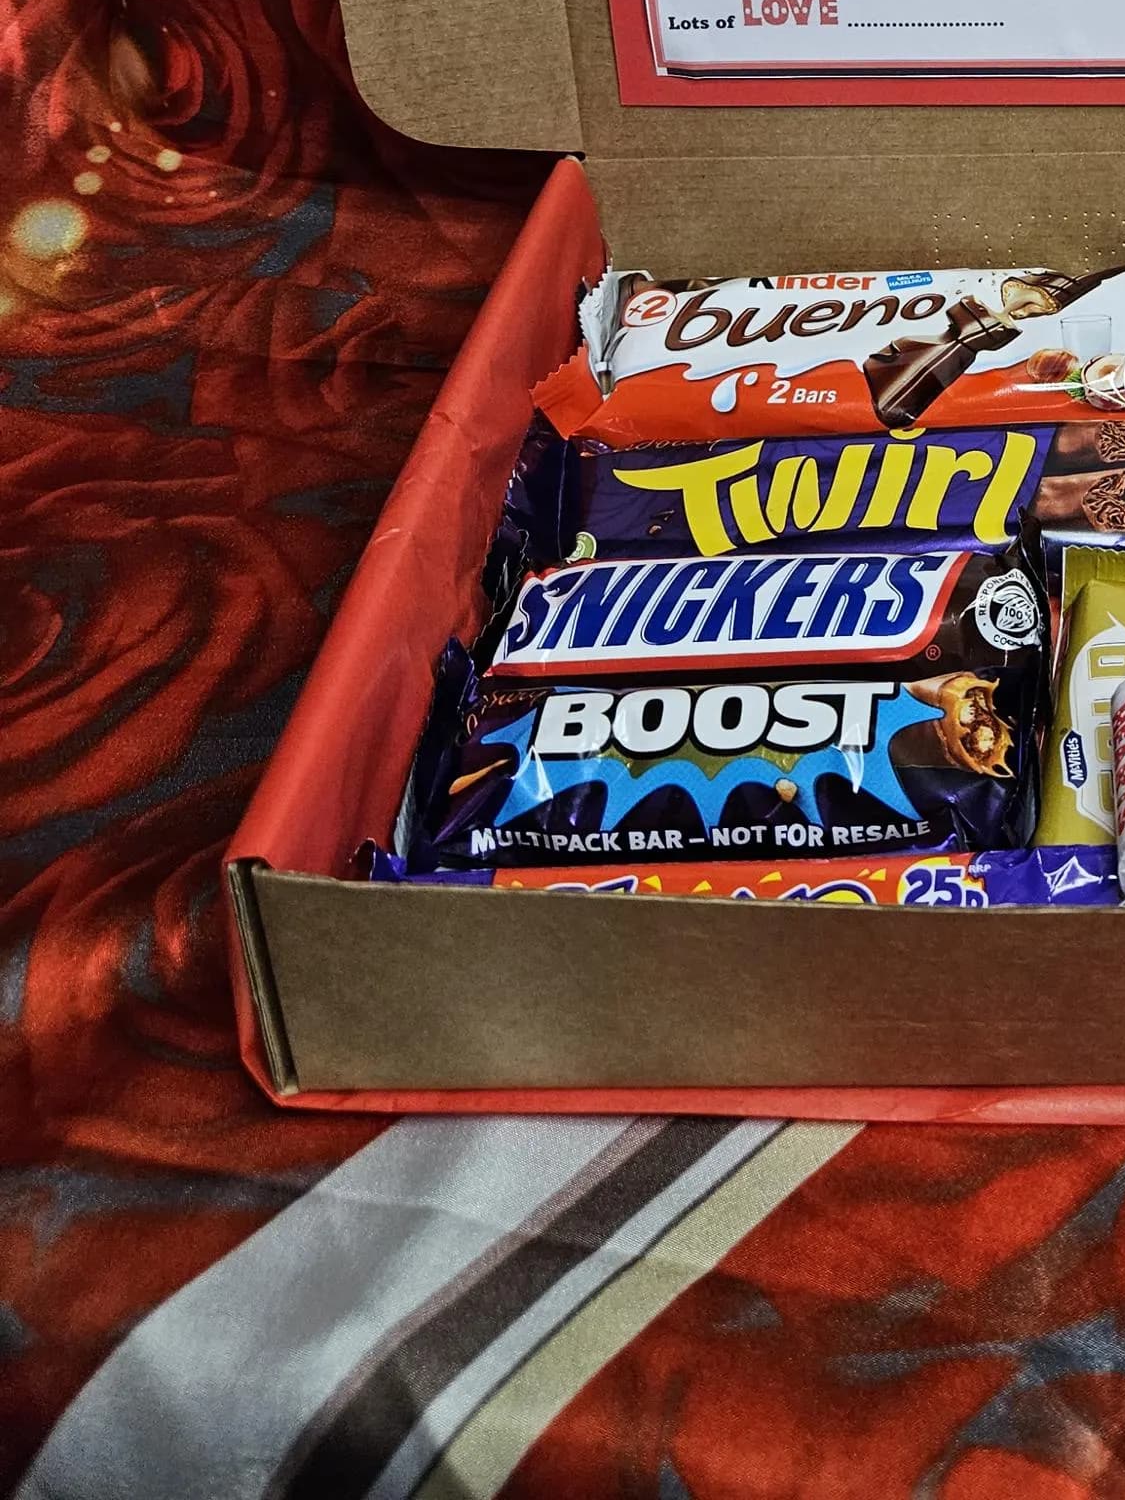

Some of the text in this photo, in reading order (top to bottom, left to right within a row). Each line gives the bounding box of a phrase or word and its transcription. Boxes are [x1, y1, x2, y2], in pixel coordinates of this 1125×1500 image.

[667, 16, 710, 30] Lots
[715, 15, 736, 29] of
[664, 289, 946, 351] bueno
[767, 380, 837, 405] 2 Bars
[612, 428, 1037, 557] Twirl
[504, 554, 946, 658] SNICKERS
[533, 682, 898, 756] BOOST
[471, 828, 622, 854] MULTIPACK
[628, 828, 684, 850] BAR
[711, 825, 768, 847] NOT
[774, 823, 825, 846] FOR
[831, 819, 931, 845] RESALE
[968, 864, 991, 873] RRP
